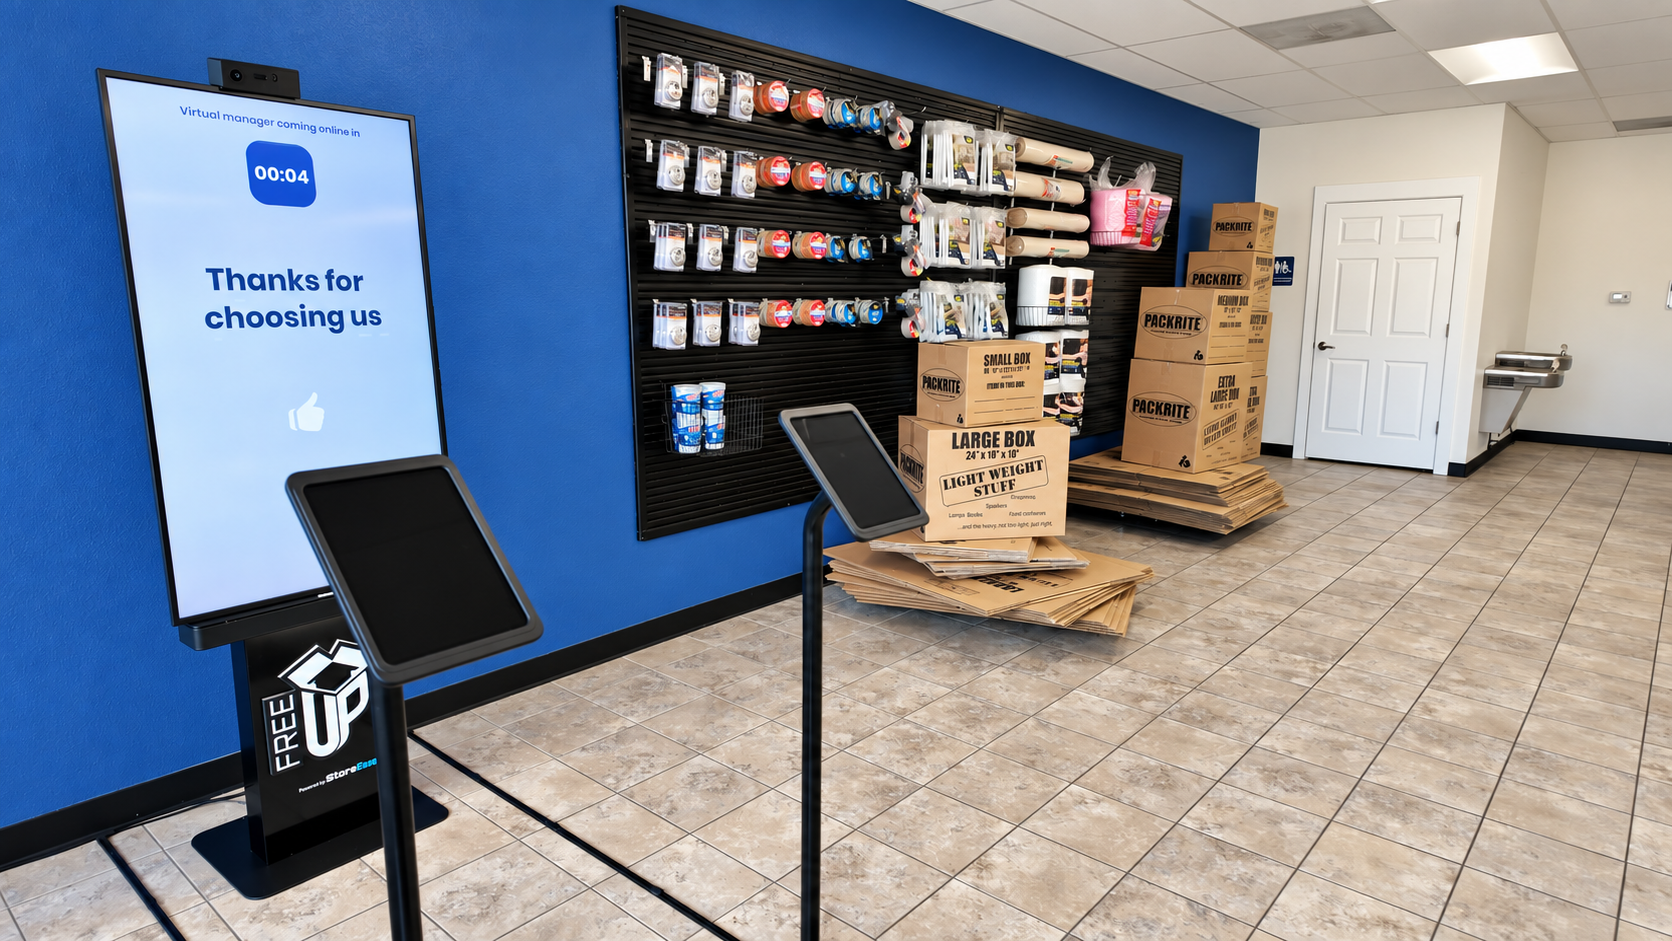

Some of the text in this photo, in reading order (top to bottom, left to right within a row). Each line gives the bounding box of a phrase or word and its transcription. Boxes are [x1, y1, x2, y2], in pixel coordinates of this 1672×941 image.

[179, 105, 361, 138] Virtual manager coming online in
[254, 165, 310, 184] 00:04
[1215, 221, 1253, 232] PACKRITE
[205, 267, 364, 292] Thanks for
[1192, 273, 1243, 286] PACKRITE
[204, 303, 382, 333] choosing us
[1144, 312, 1202, 332] PACKRITE
[983, 352, 1031, 367] SMALL BOX
[922, 375, 961, 394] PACKRITE
[1132, 398, 1191, 420] PACKRITE
[951, 430, 1036, 450] LARGE BOX
[943, 472, 985, 491] LIGHT
[989, 459, 1044, 478] WEIGHT
[974, 478, 1017, 497] STUFF
[269, 670, 370, 772] FREE UP
